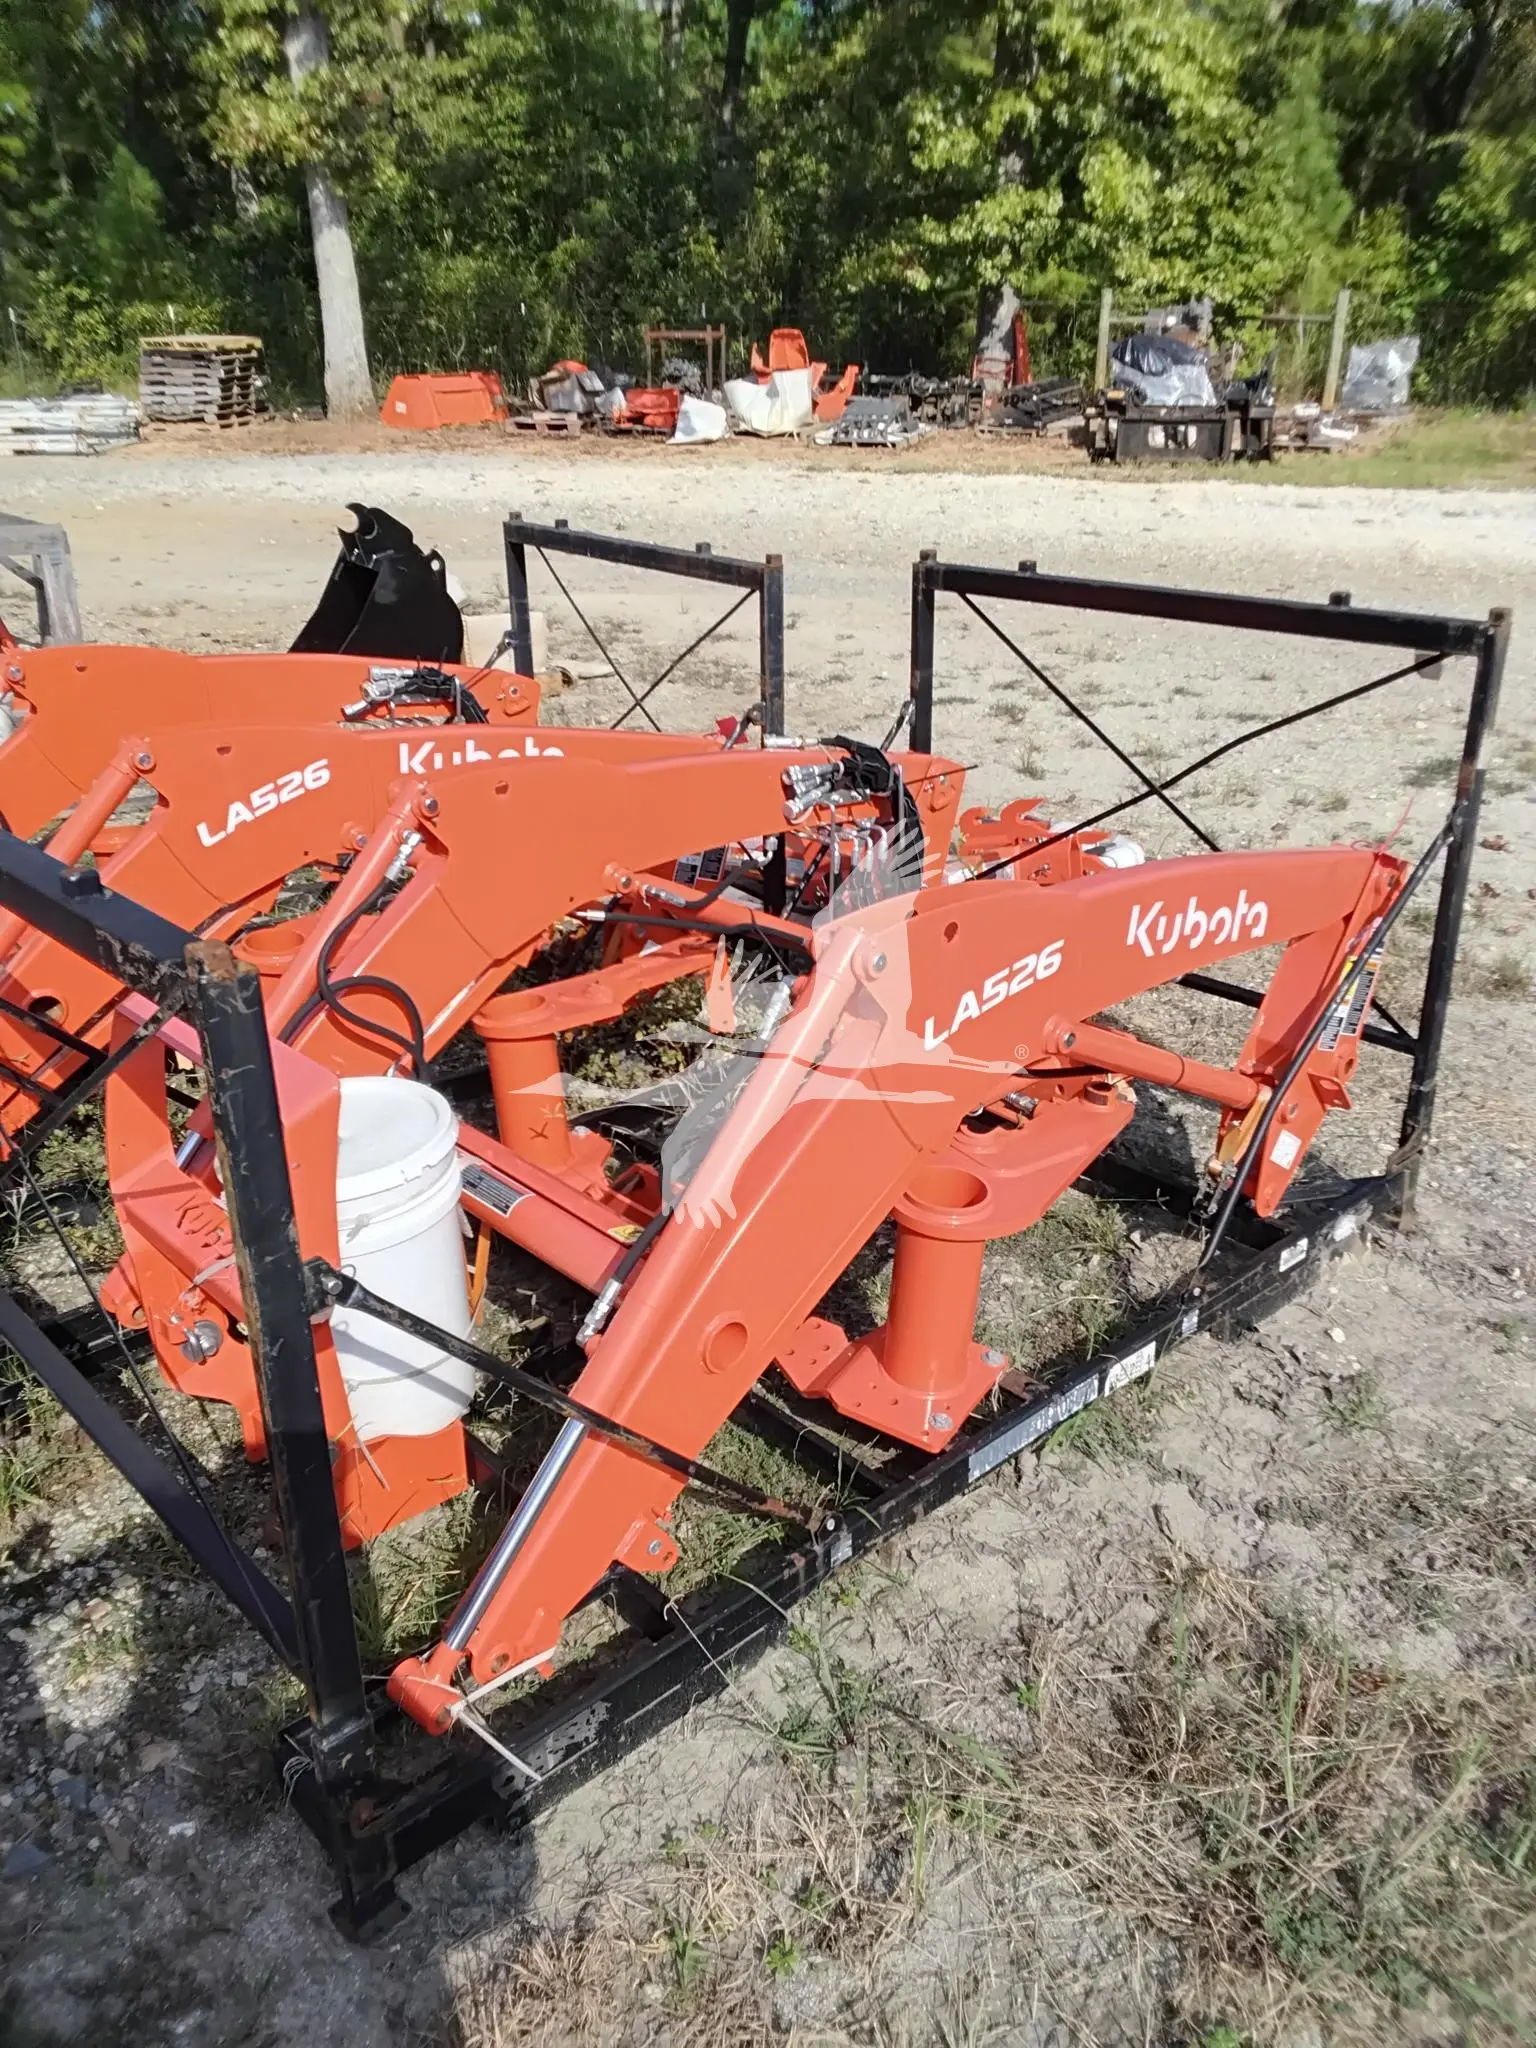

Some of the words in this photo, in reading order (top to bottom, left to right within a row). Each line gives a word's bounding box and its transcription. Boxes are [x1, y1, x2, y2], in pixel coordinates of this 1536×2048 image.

[196, 758, 332, 847] LA526
[1126, 889, 1268, 957] Kubota
[924, 939, 1065, 1051] LA526
